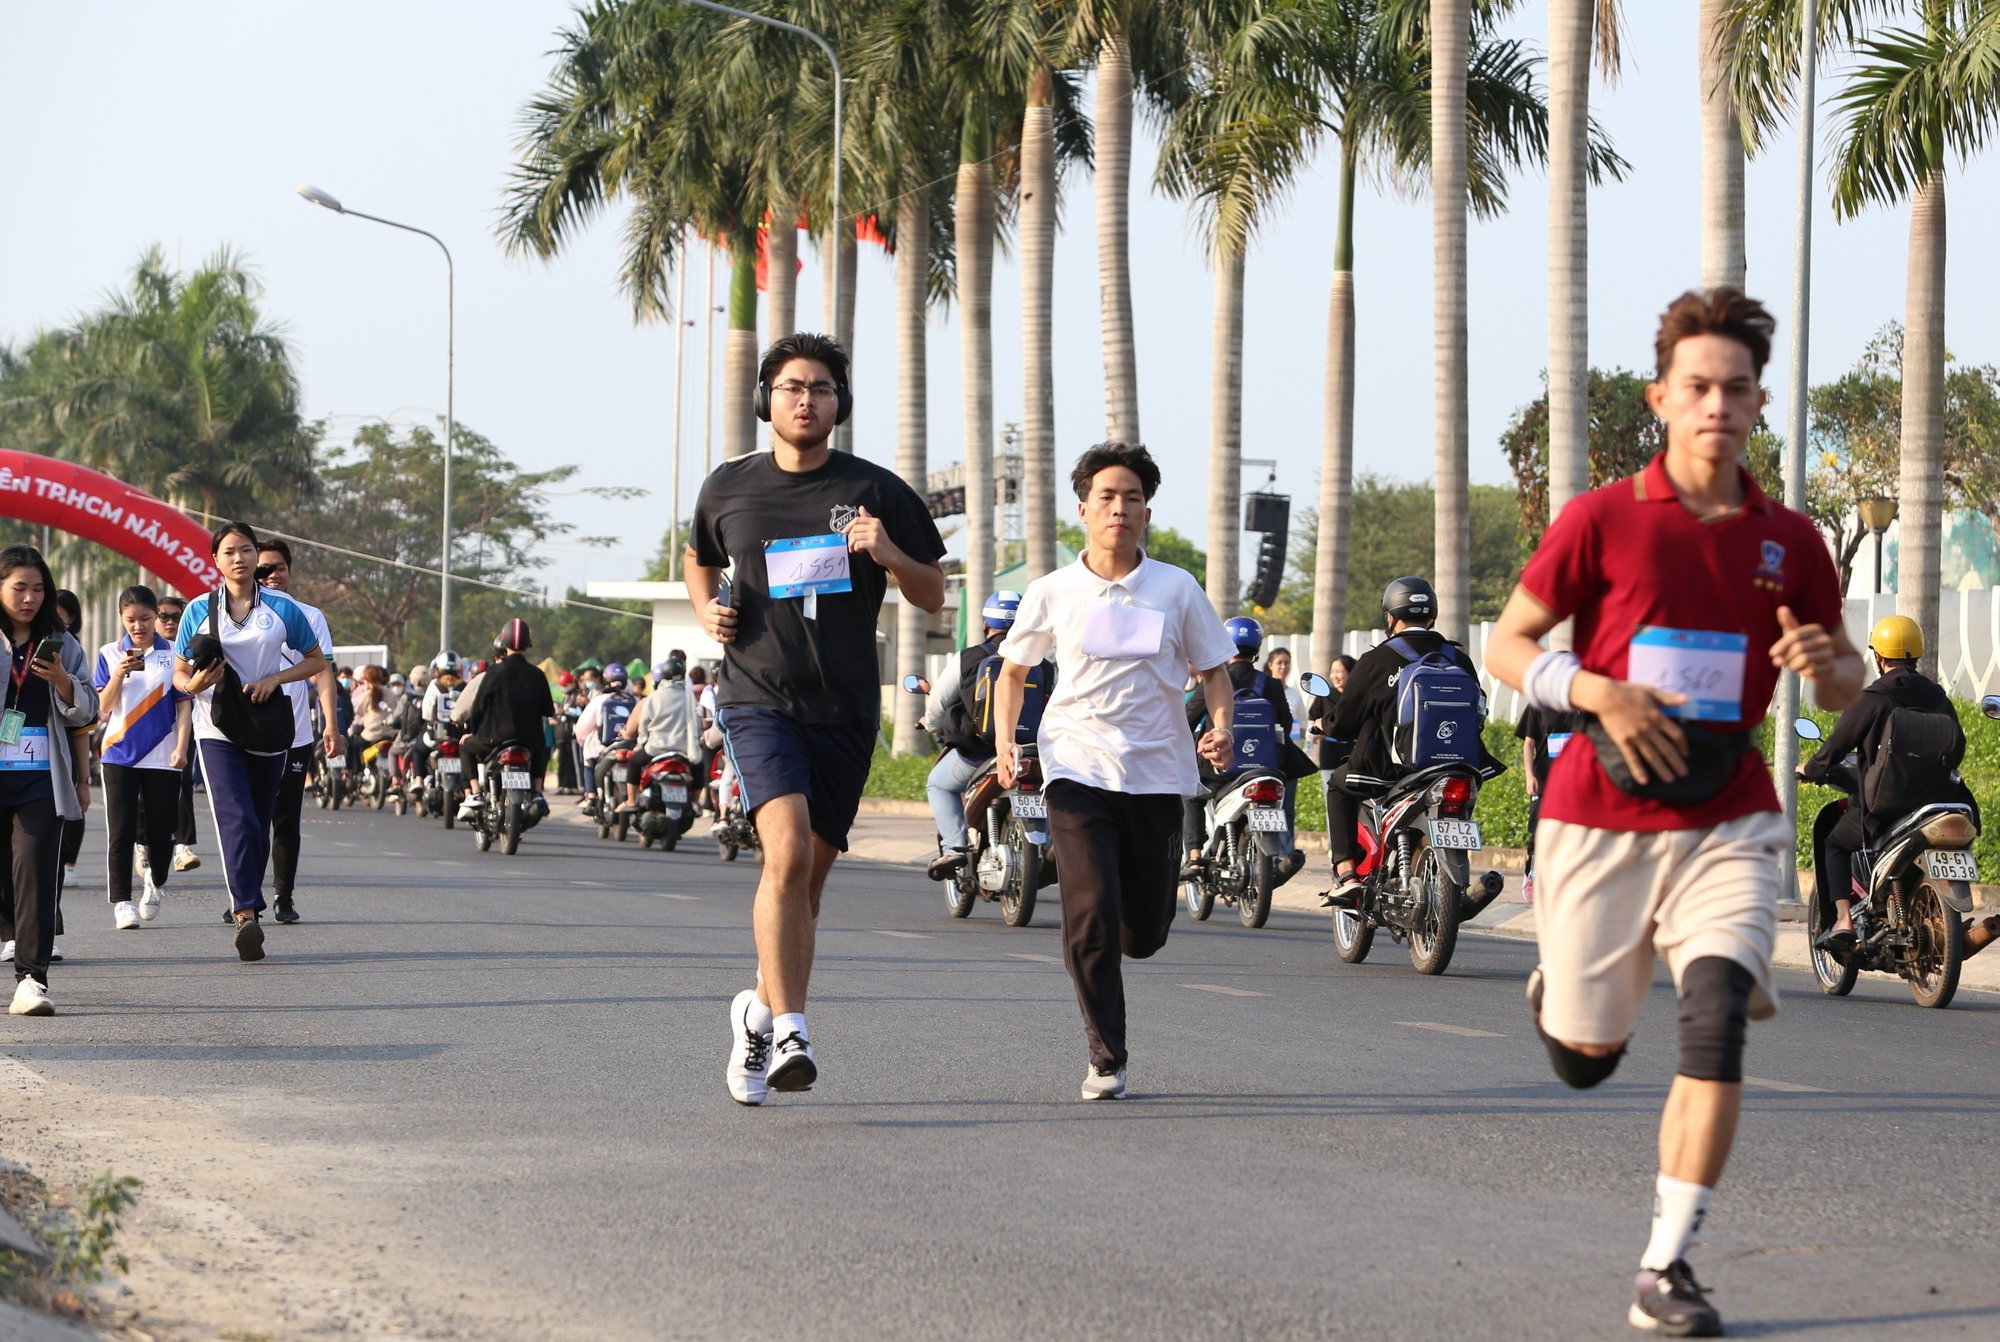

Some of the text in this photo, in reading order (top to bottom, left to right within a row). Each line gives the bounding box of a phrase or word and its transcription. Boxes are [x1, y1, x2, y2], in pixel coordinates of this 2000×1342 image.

[0, 467, 31, 494] ÊN
[34, 477, 124, 525] TP.HCM
[124, 513, 181, 556] NĂM
[836, 513, 854, 529] NHL
[789, 555, 846, 582] 1559
[1015, 806, 1047, 817] 260.1
[1253, 810, 1279, 820] 65-F1
[1252, 820, 1285, 831] 468.22
[1437, 821, 1472, 835] 67-L2
[1436, 834, 1477, 848] 669.38
[1935, 851, 1967, 865] 49-G1
[1932, 865, 1976, 879] 005.38
